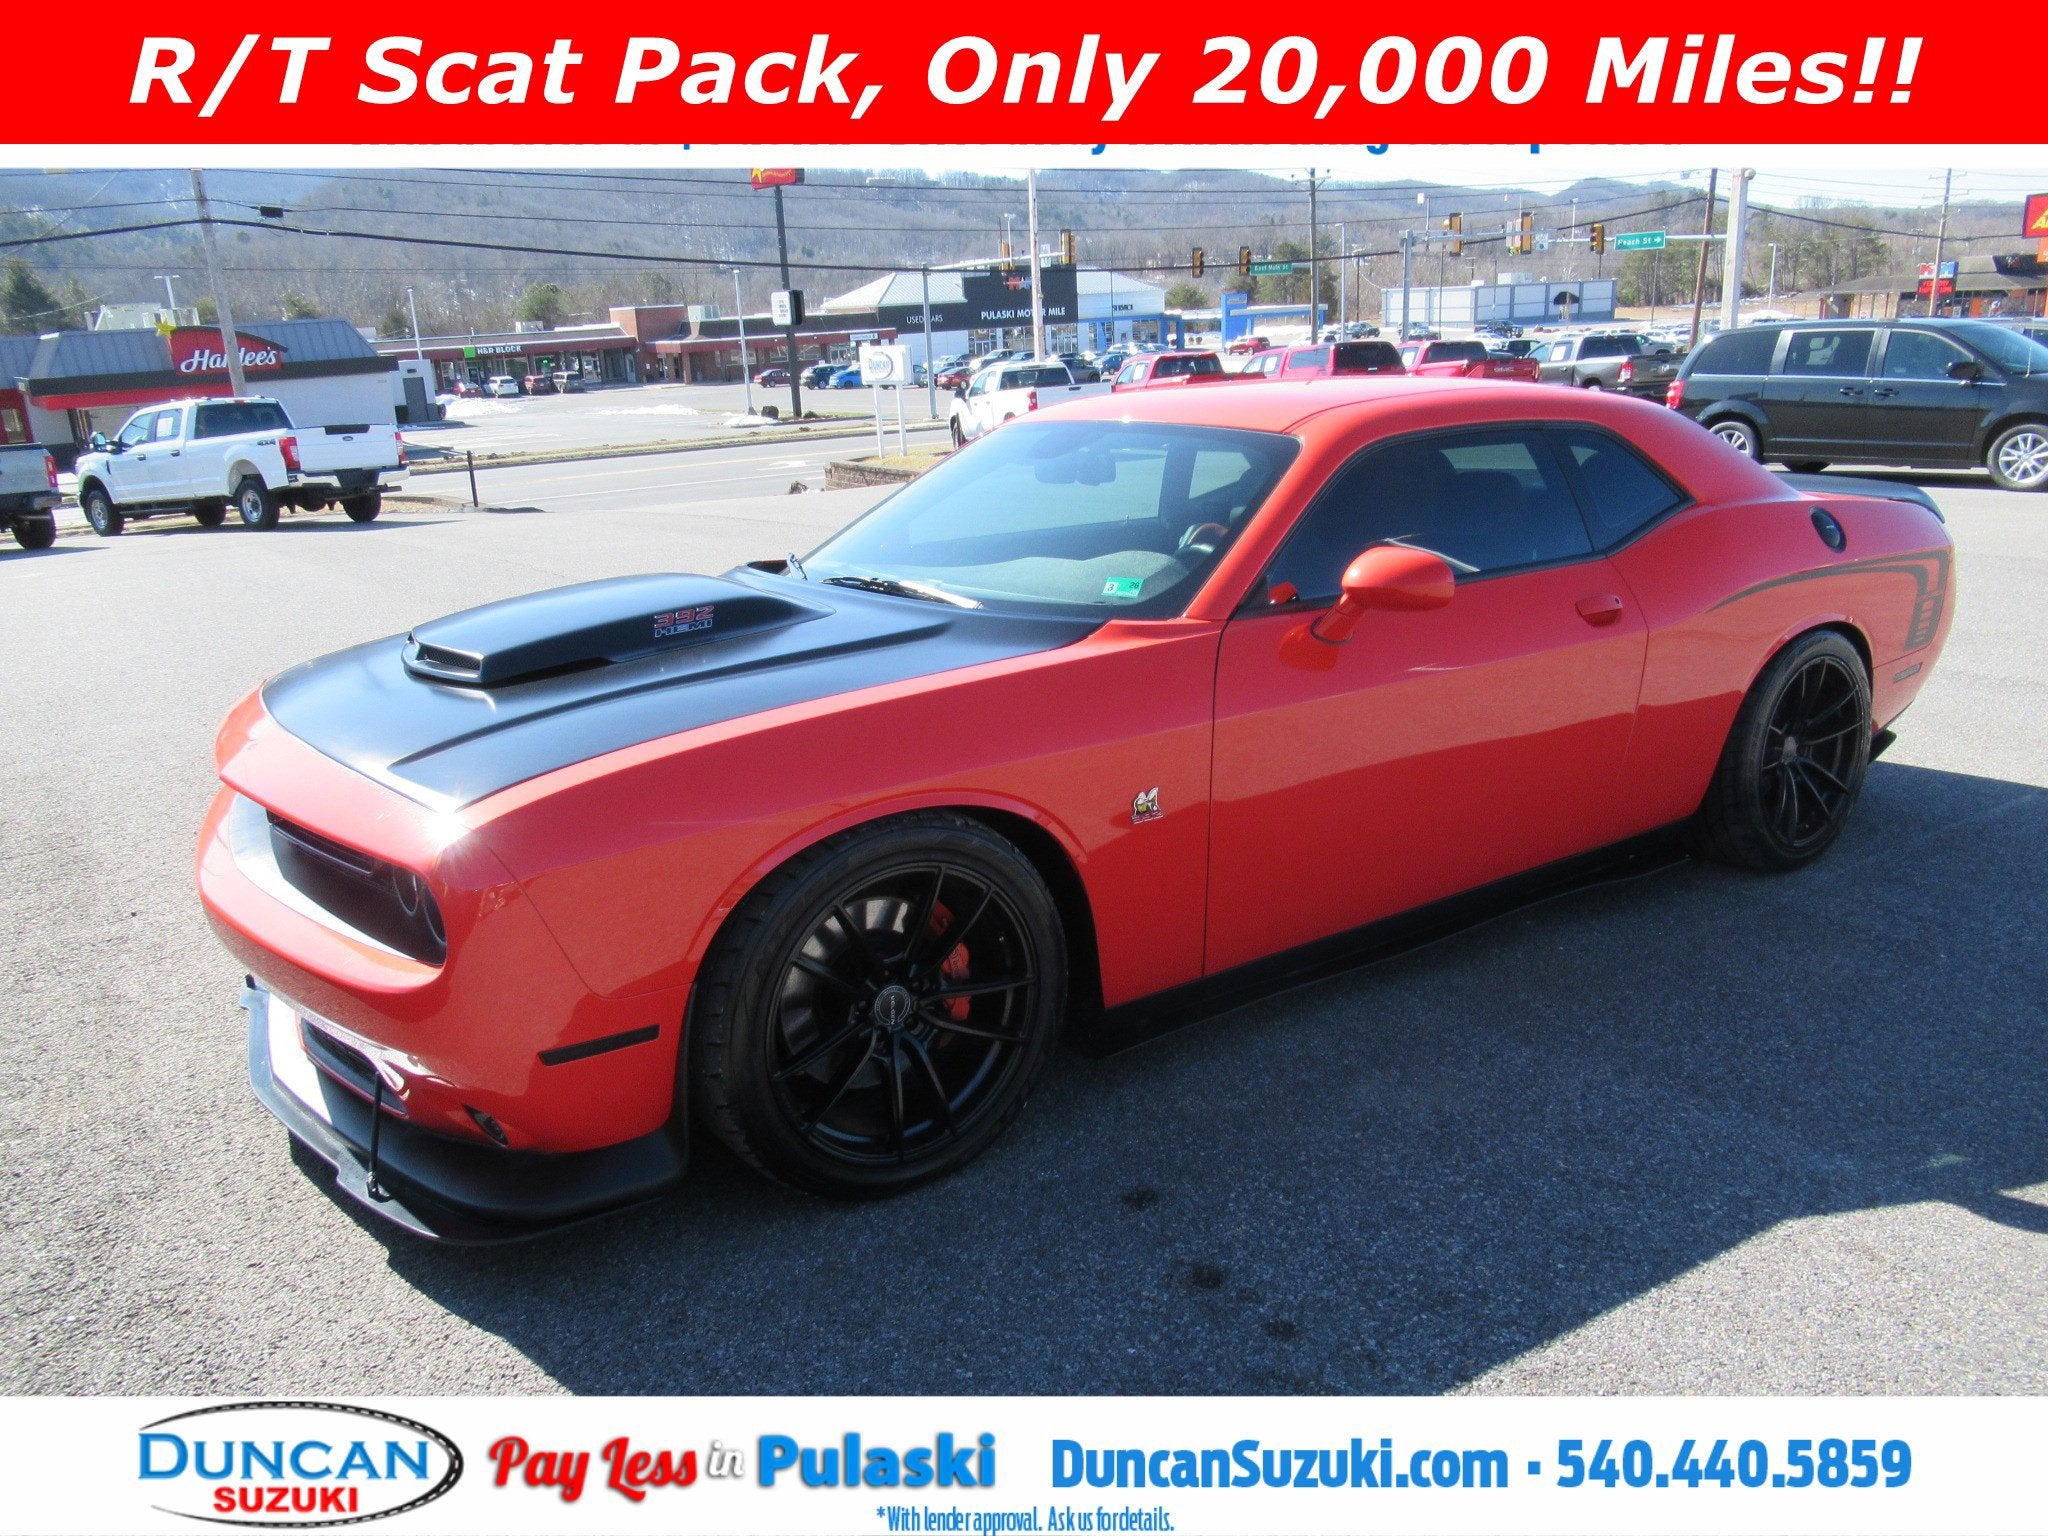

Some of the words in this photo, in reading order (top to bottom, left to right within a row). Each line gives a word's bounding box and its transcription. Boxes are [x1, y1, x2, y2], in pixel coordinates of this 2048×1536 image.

[906, 315, 924, 324] USED
[980, 309, 1015, 320] PULASKI
[1048, 307, 1066, 317] MILE
[477, 347, 495, 355] H&R
[496, 345, 521, 354] BLOCK
[653, 604, 715, 629] 392
[654, 619, 713, 638] HEMI
